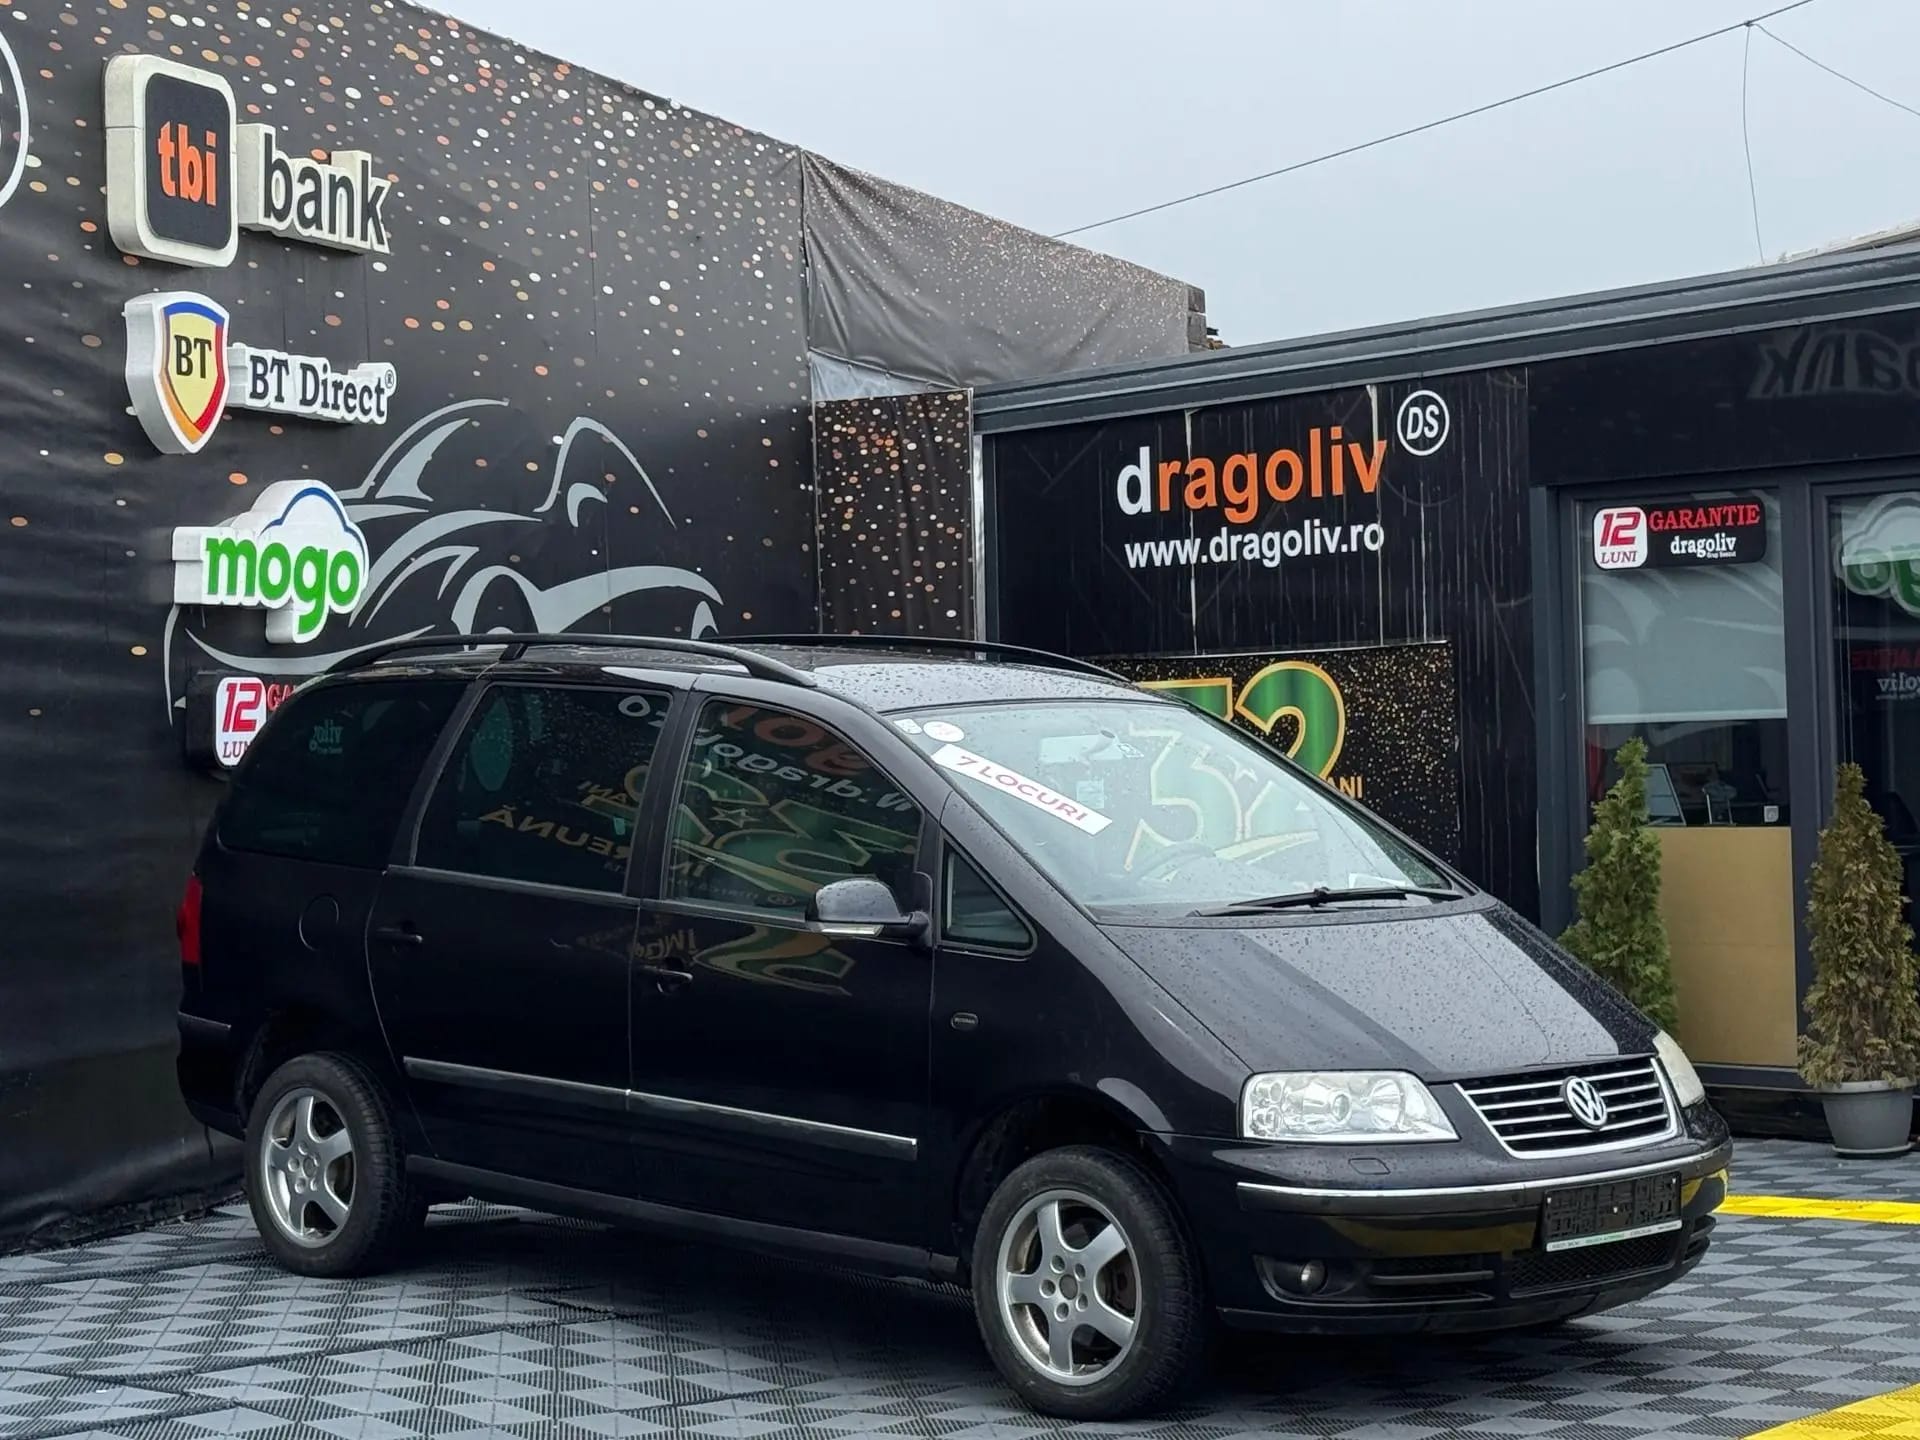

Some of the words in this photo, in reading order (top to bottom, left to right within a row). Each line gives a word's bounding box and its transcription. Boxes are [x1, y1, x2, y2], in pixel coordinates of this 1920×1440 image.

[157, 120, 217, 207] tbi
[263, 132, 388, 246] bank
[174, 334, 212, 380] BT
[249, 353, 290, 404] BT
[1406, 403, 1440, 440] DS
[1116, 425, 1388, 524] dragoliv
[1124, 518, 1385, 568] www.dragoliv.ro
[1599, 511, 1641, 547] 12
[1649, 504, 1761, 531] GARANTIE
[1670, 532, 1737, 558] dragoliv
[1600, 550, 1638, 565] LUNI
[205, 537, 361, 635] mogo
[222, 682, 263, 733] 12
[223, 740, 250, 759] LU
[956, 755, 978, 767] 7
[979, 765, 1089, 822] LOCURI
